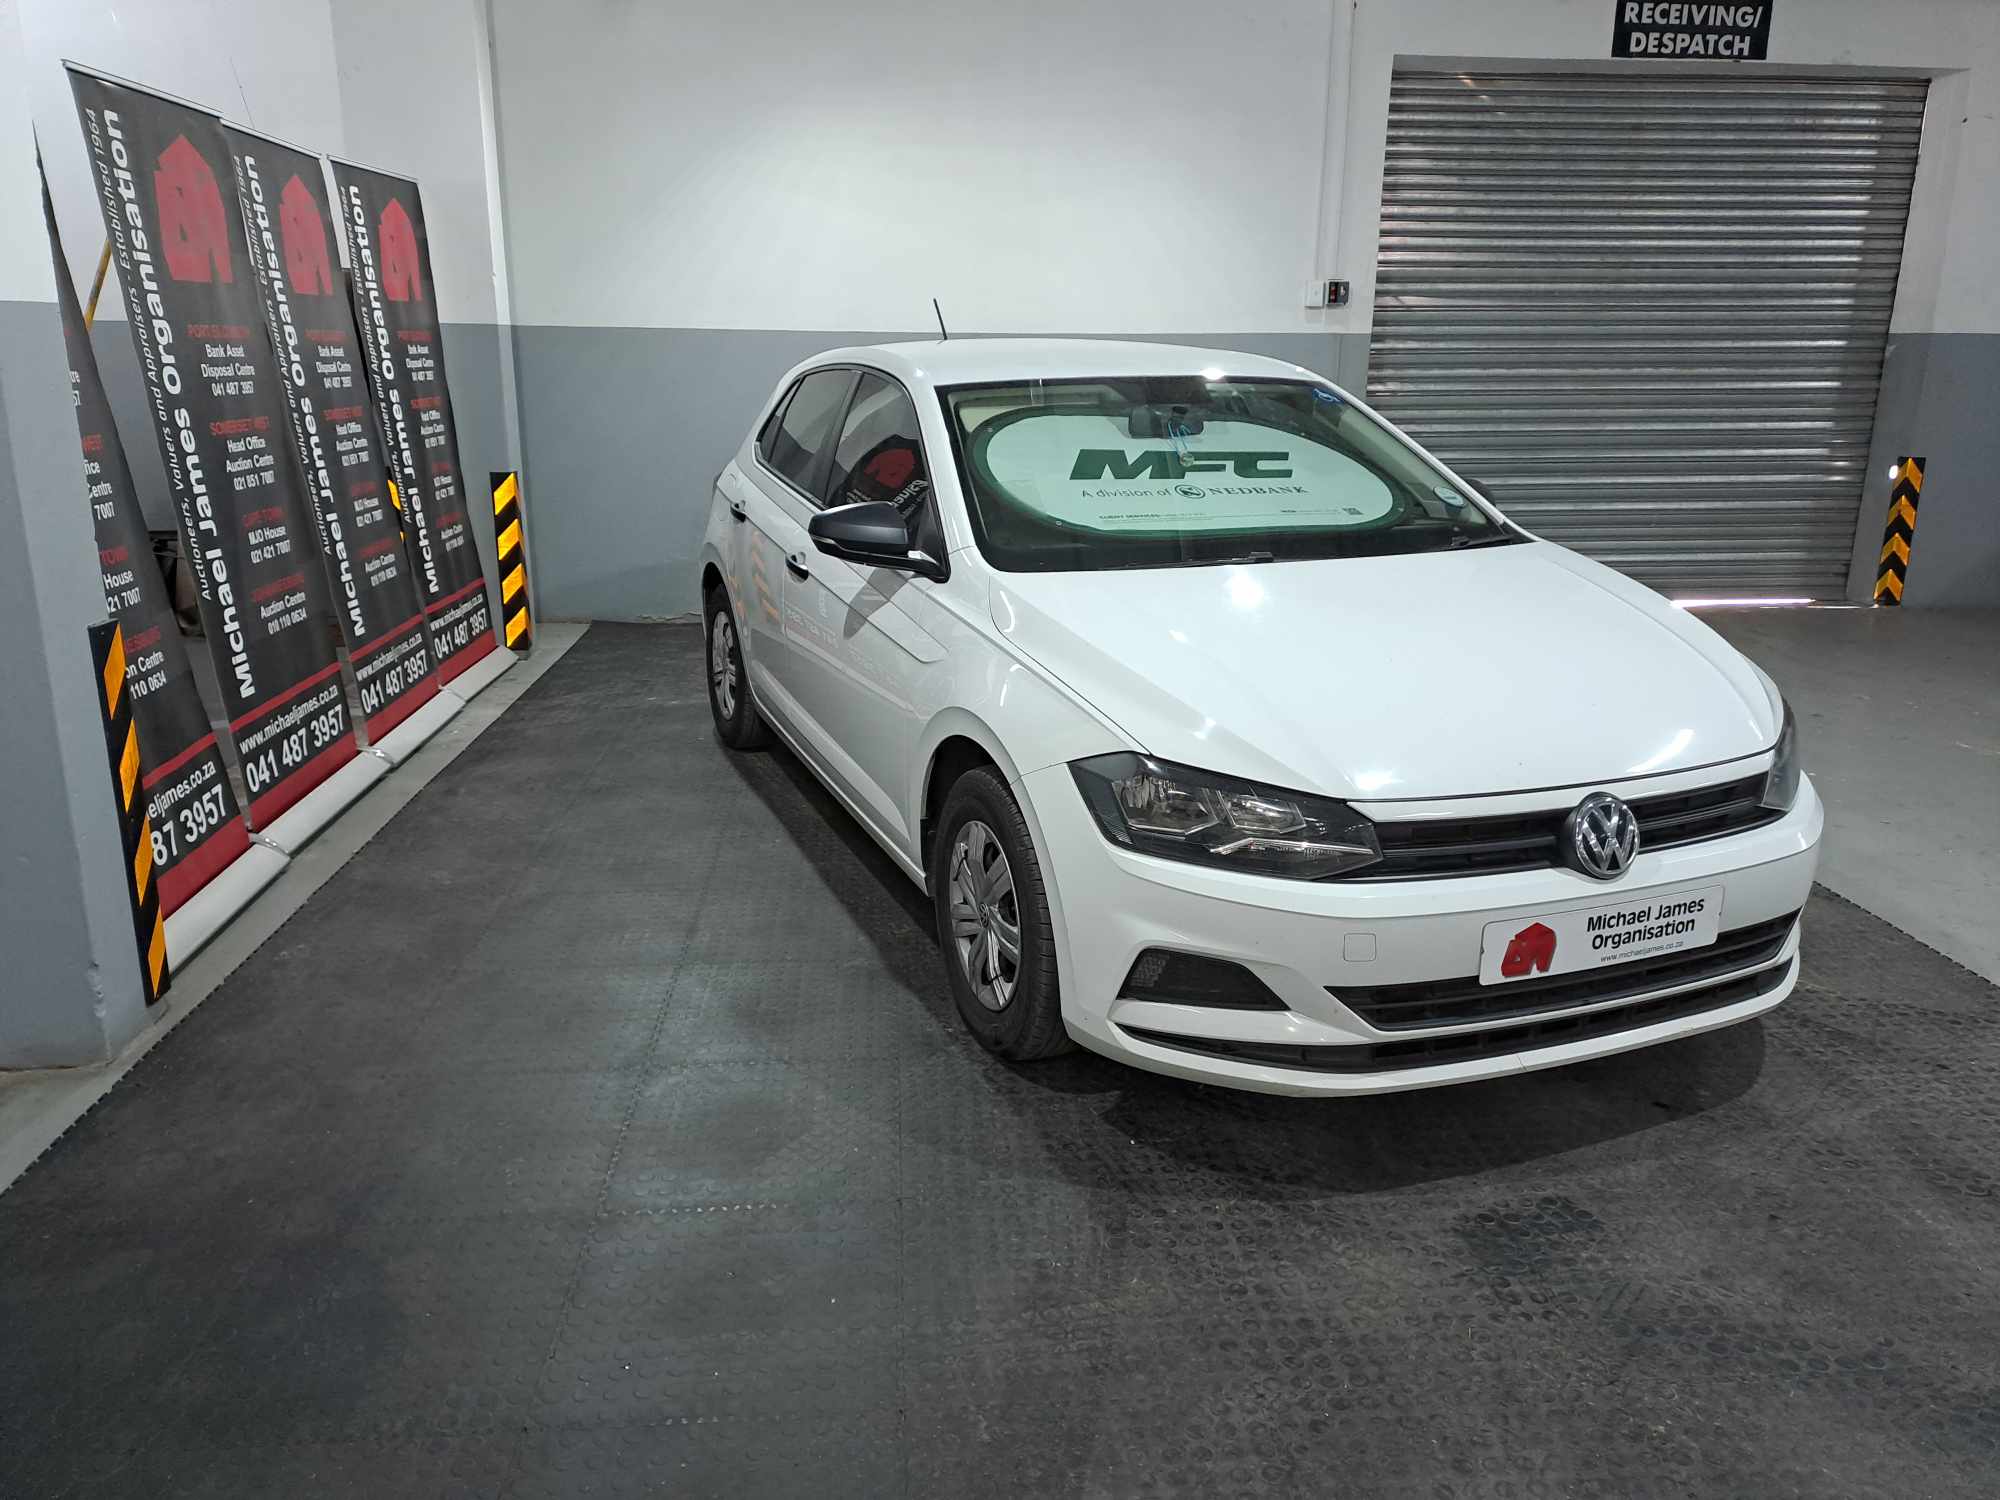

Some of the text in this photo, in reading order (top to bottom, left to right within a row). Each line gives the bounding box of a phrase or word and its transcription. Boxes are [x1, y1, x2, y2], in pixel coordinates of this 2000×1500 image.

[1624, 1, 1764, 28] RECEIVING/
[1629, 32, 1750, 56] DESPATCH
[85, 107, 106, 156] 1964
[96, 160, 132, 270] Established
[244, 155, 306, 387] Organisation
[349, 185, 395, 380] Organisation
[127, 286, 160, 383] Appraisers
[205, 343, 226, 358] Bank
[200, 363, 235, 380] Disposal
[373, 374, 384, 399] and
[103, 109, 256, 699] Michael James Organisation
[150, 386, 168, 422] and
[211, 382, 225, 397] 041
[283, 379, 296, 408] and
[226, 438, 245, 454] Head
[292, 412, 310, 464] Valuers
[300, 397, 334, 503] James
[389, 388, 416, 480] James
[162, 426, 184, 490] Valuers
[226, 457, 253, 473] Auction
[1069, 449, 1293, 480] MFC
[233, 475, 247, 491] 021
[1082, 486, 1312, 498] A division of NEDBANK
[94, 501, 115, 520] 7007
[180, 497, 212, 601] Auctioneers,
[407, 487, 440, 594] Michael
[103, 570, 134, 590] House
[326, 512, 366, 637] Michael
[121, 587, 142, 608] 7007
[260, 600, 285, 620] Auction
[434, 608, 488, 658] 041 487 3957
[138, 650, 165, 674] Centre
[130, 680, 148, 700] 110
[148, 669, 167, 692] 0634
[361, 649, 428, 714] 041 487 3957
[239, 684, 339, 754] www.michaeljames.co.za
[246, 703, 344, 793] 041 487 3957
[147, 760, 217, 821] eljames.co.za
[151, 783, 227, 866] 87 3957
[1587, 898, 1705, 933] Michael James
[1591, 918, 1696, 951] Organisation
